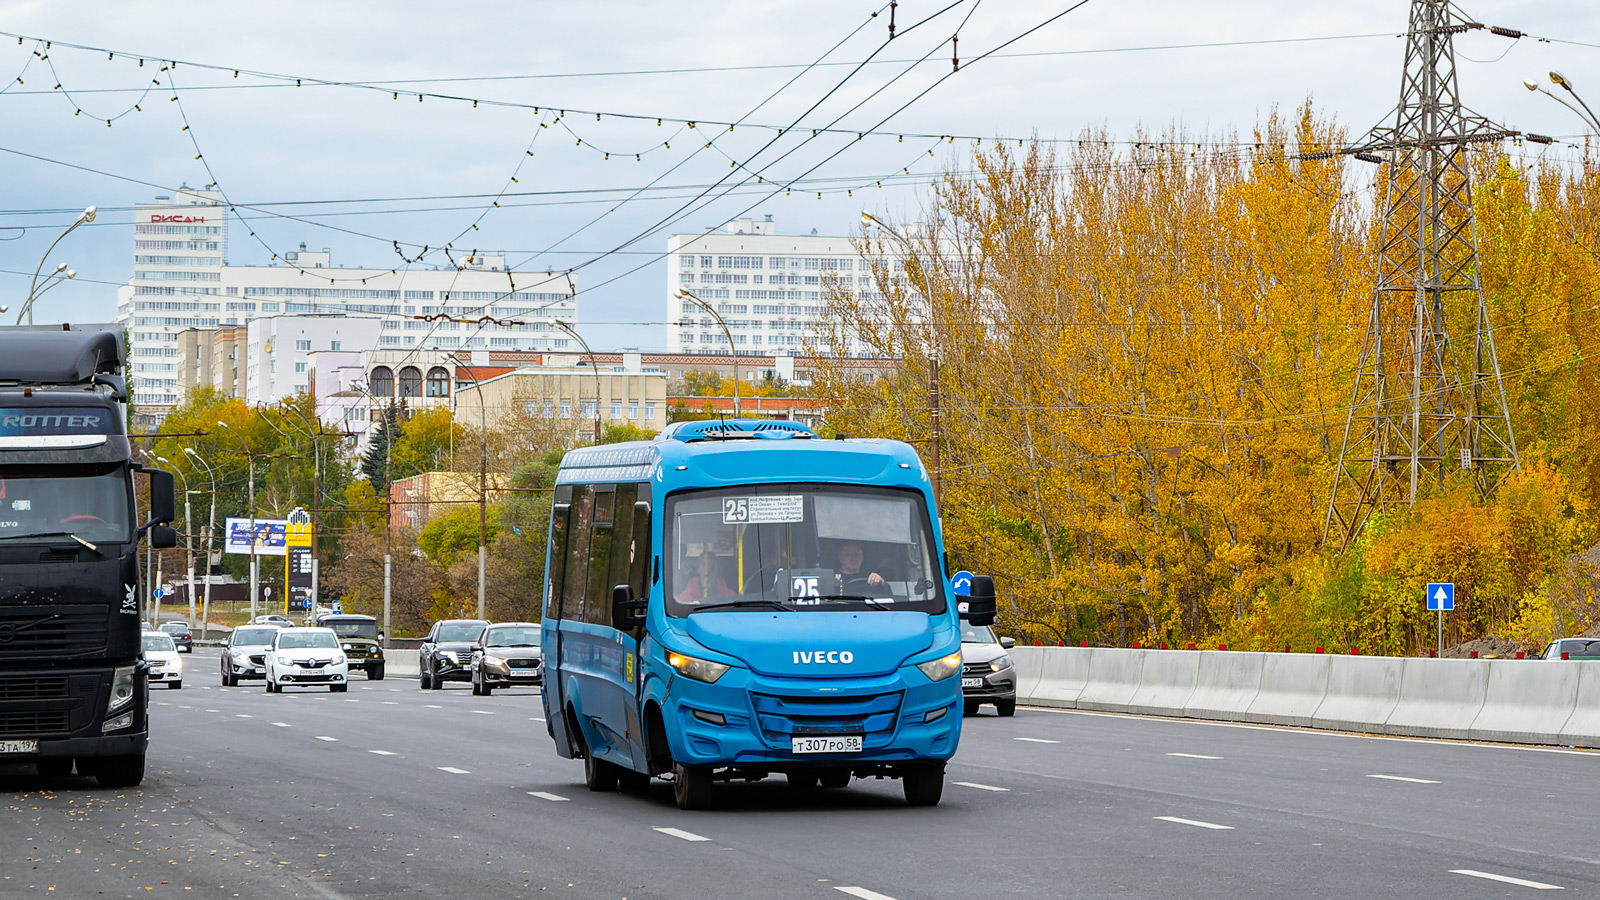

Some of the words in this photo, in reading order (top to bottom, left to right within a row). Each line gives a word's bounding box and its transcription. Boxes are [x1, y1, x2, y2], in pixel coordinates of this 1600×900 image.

[151, 214, 204, 223] РИСАН
[0, 415, 100, 427] ROTTER
[725, 499, 748, 521] 25
[793, 578, 820, 605] 25
[792, 651, 854, 664] IVECO
[846, 738, 858, 747] 58
